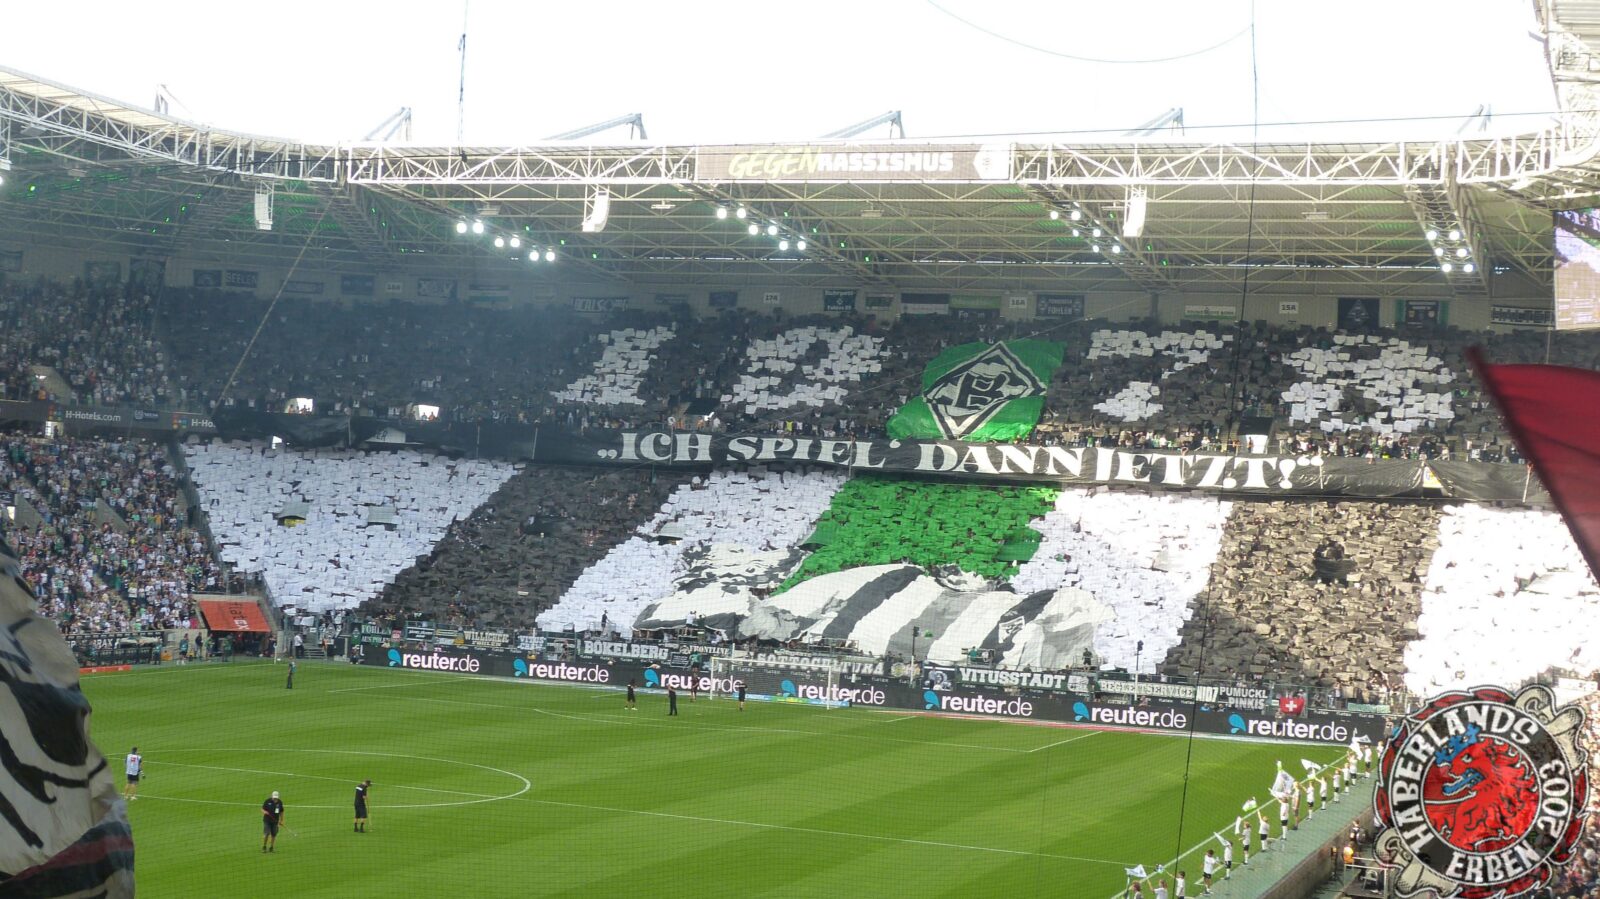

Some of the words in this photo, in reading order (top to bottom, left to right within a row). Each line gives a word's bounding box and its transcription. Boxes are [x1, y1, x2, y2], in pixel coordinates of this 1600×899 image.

[728, 147, 822, 178] GEGEN
[818, 152, 954, 173] RASSISMUS
[1281, 303, 1296, 311] 15A
[65, 410, 121, 422] H-Hotels.com
[914, 443, 1082, 477] DANN
[463, 630, 510, 643] WILLICHER
[402, 652, 480, 672] reuter.de
[528, 662, 609, 683] reuter.de
[959, 667, 1067, 689] VITUSSTADT
[798, 681, 886, 705] reuter.de
[1219, 686, 1268, 699] PUMUCKL
[941, 696, 1033, 717] reuter.de
[1228, 697, 1266, 711] PINKIS
[1091, 706, 1187, 729] reuter.de
[1248, 718, 1349, 742] reuter.de
